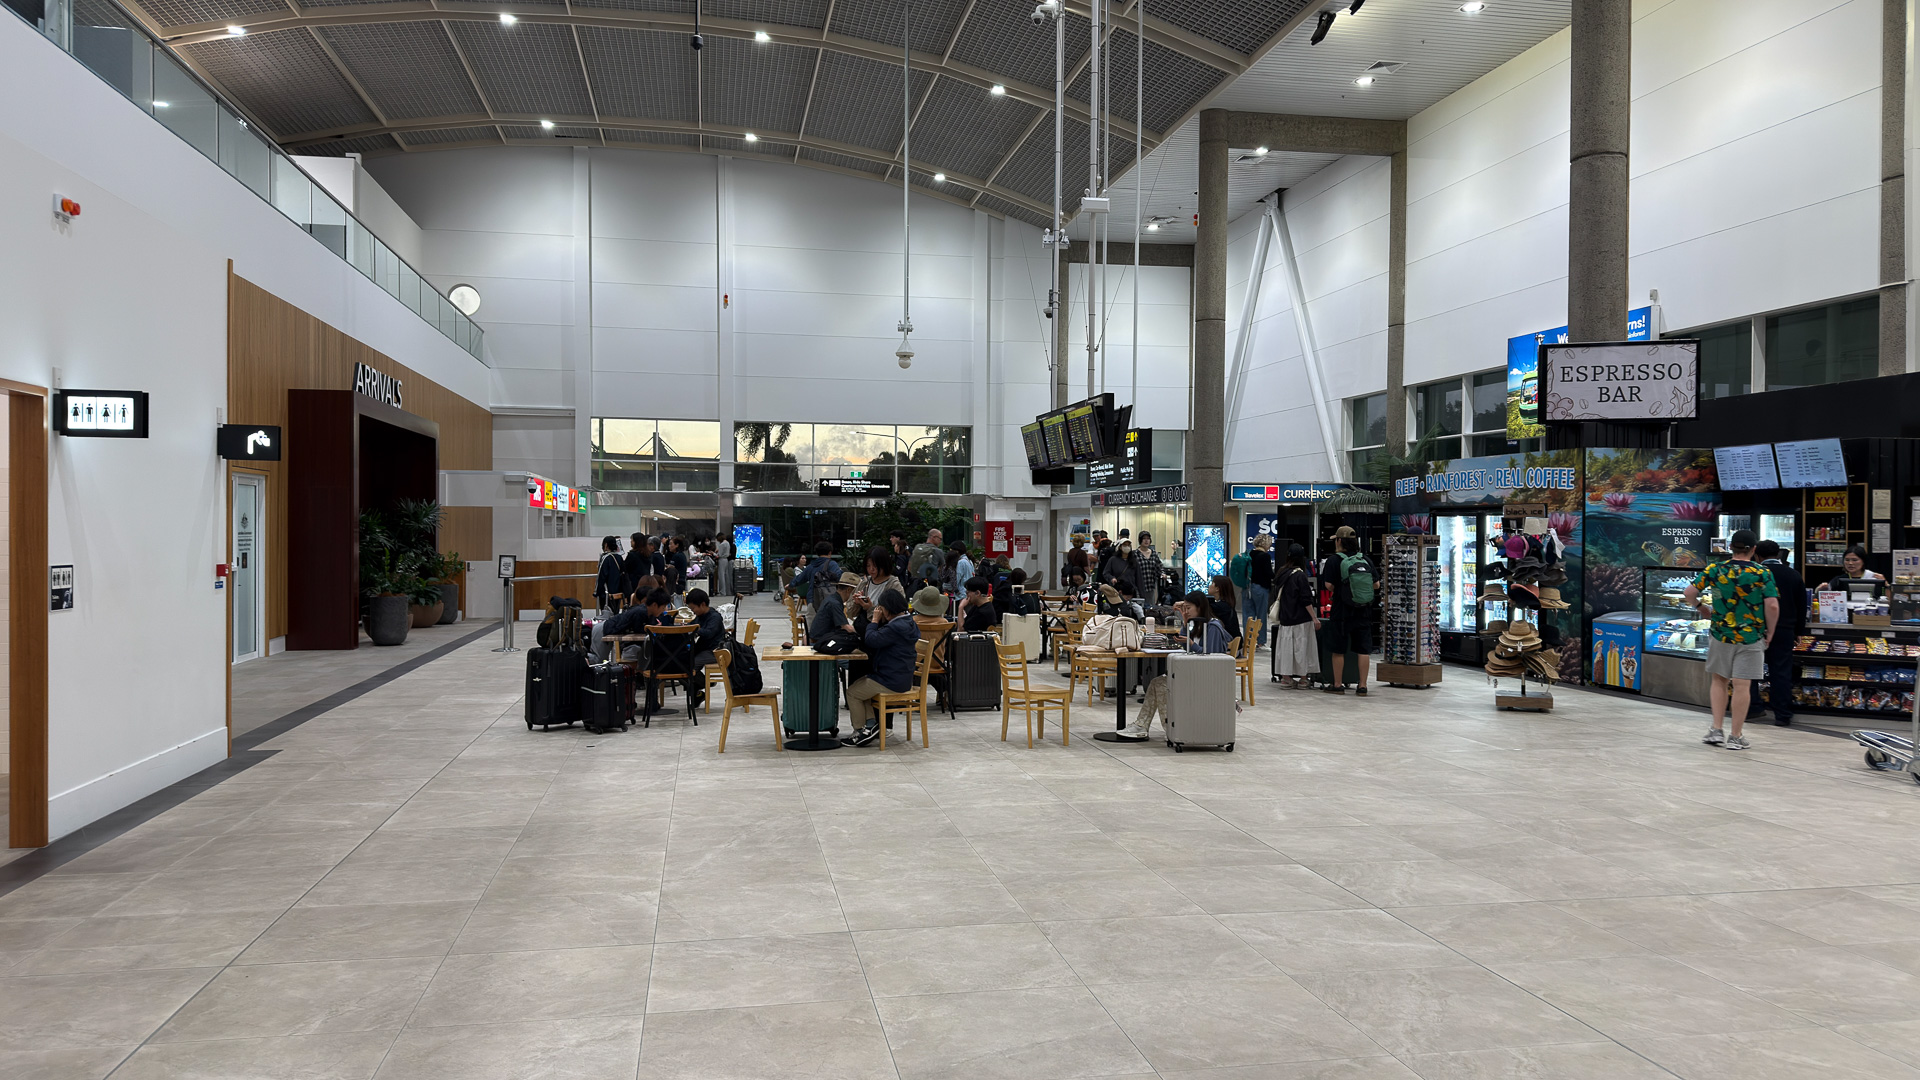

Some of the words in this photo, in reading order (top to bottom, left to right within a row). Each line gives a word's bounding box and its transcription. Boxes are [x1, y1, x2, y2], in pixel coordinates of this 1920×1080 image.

[1560, 363, 1683, 383] ESPRESSO
[355, 362, 402, 409] ARRIVALS
[1597, 386, 1643, 402] BAR
[1396, 476, 1419, 497] REEF
[1426, 469, 1486, 493] RAINFOREST
[1495, 467, 1523, 489] REAL
[1526, 467, 1575, 490] COFFEE
[1108, 493, 1131, 505] CURRENCY
[1131, 490, 1157, 503] EXCHANGE
[1283, 489, 1336, 499] CURRENCY
[1505, 508, 1527, 516] black
[1530, 508, 1543, 516] ice
[1662, 528, 1702, 536] ESPRESSO
[1674, 537, 1690, 545] BAR
